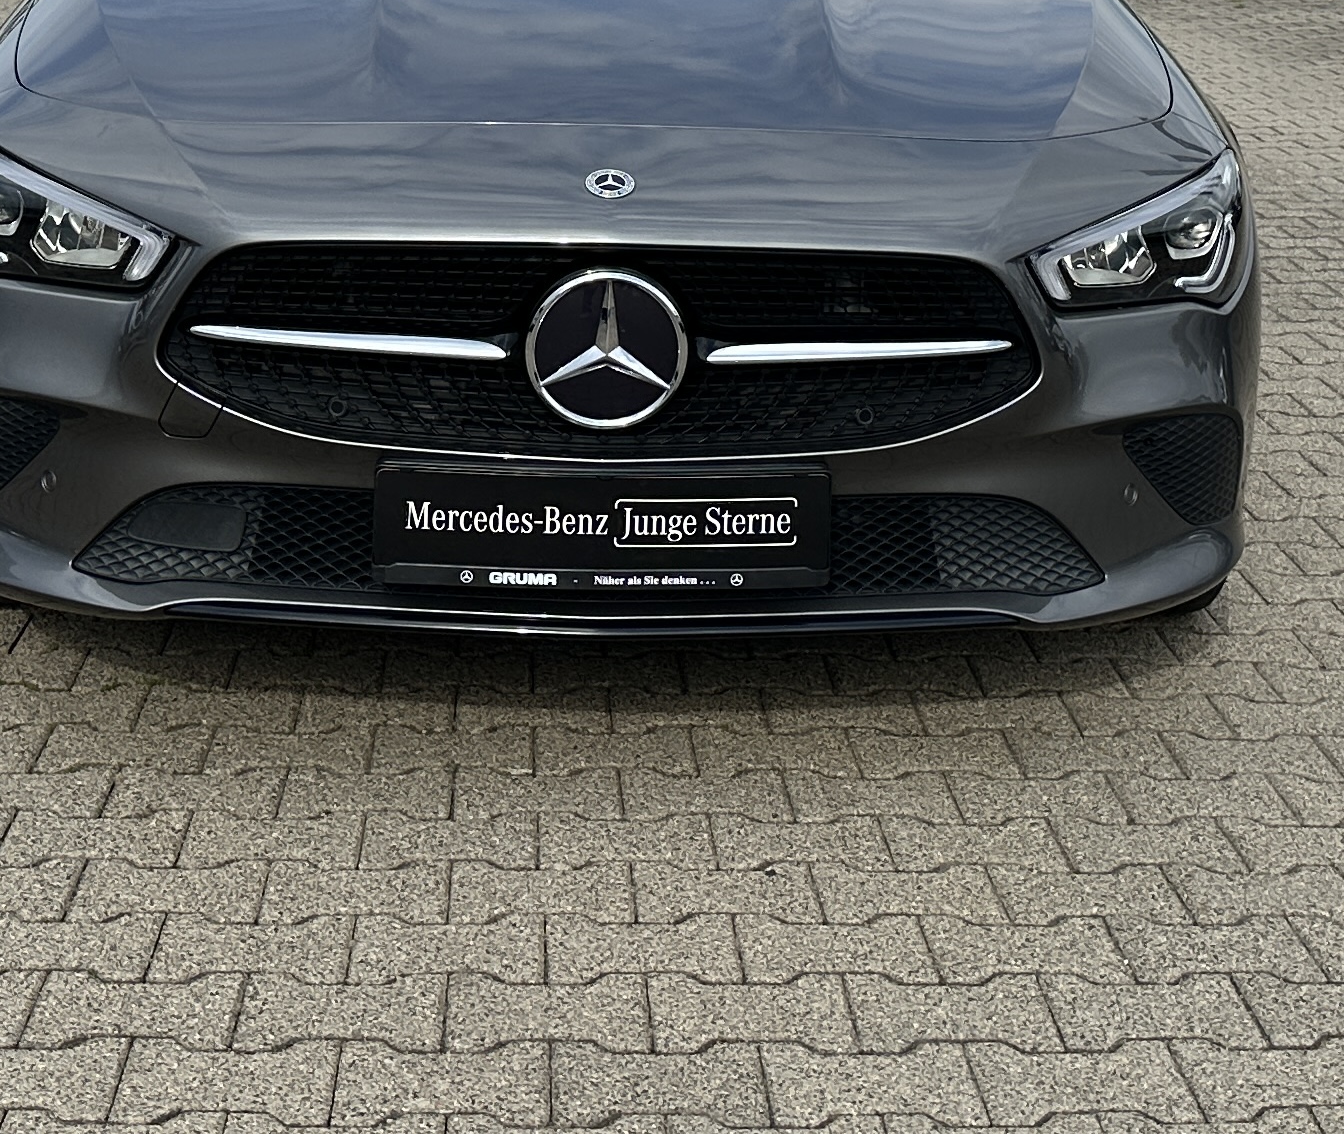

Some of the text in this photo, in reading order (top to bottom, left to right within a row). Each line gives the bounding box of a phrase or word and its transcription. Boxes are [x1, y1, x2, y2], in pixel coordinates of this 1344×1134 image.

[404, 500, 791, 542] Mercedes-Benz Junge Sterne
[489, 572, 557, 586] GRUMA
[594, 575, 625, 585] Näher
[627, 575, 641, 585] als
[644, 575, 659, 585] Sie
